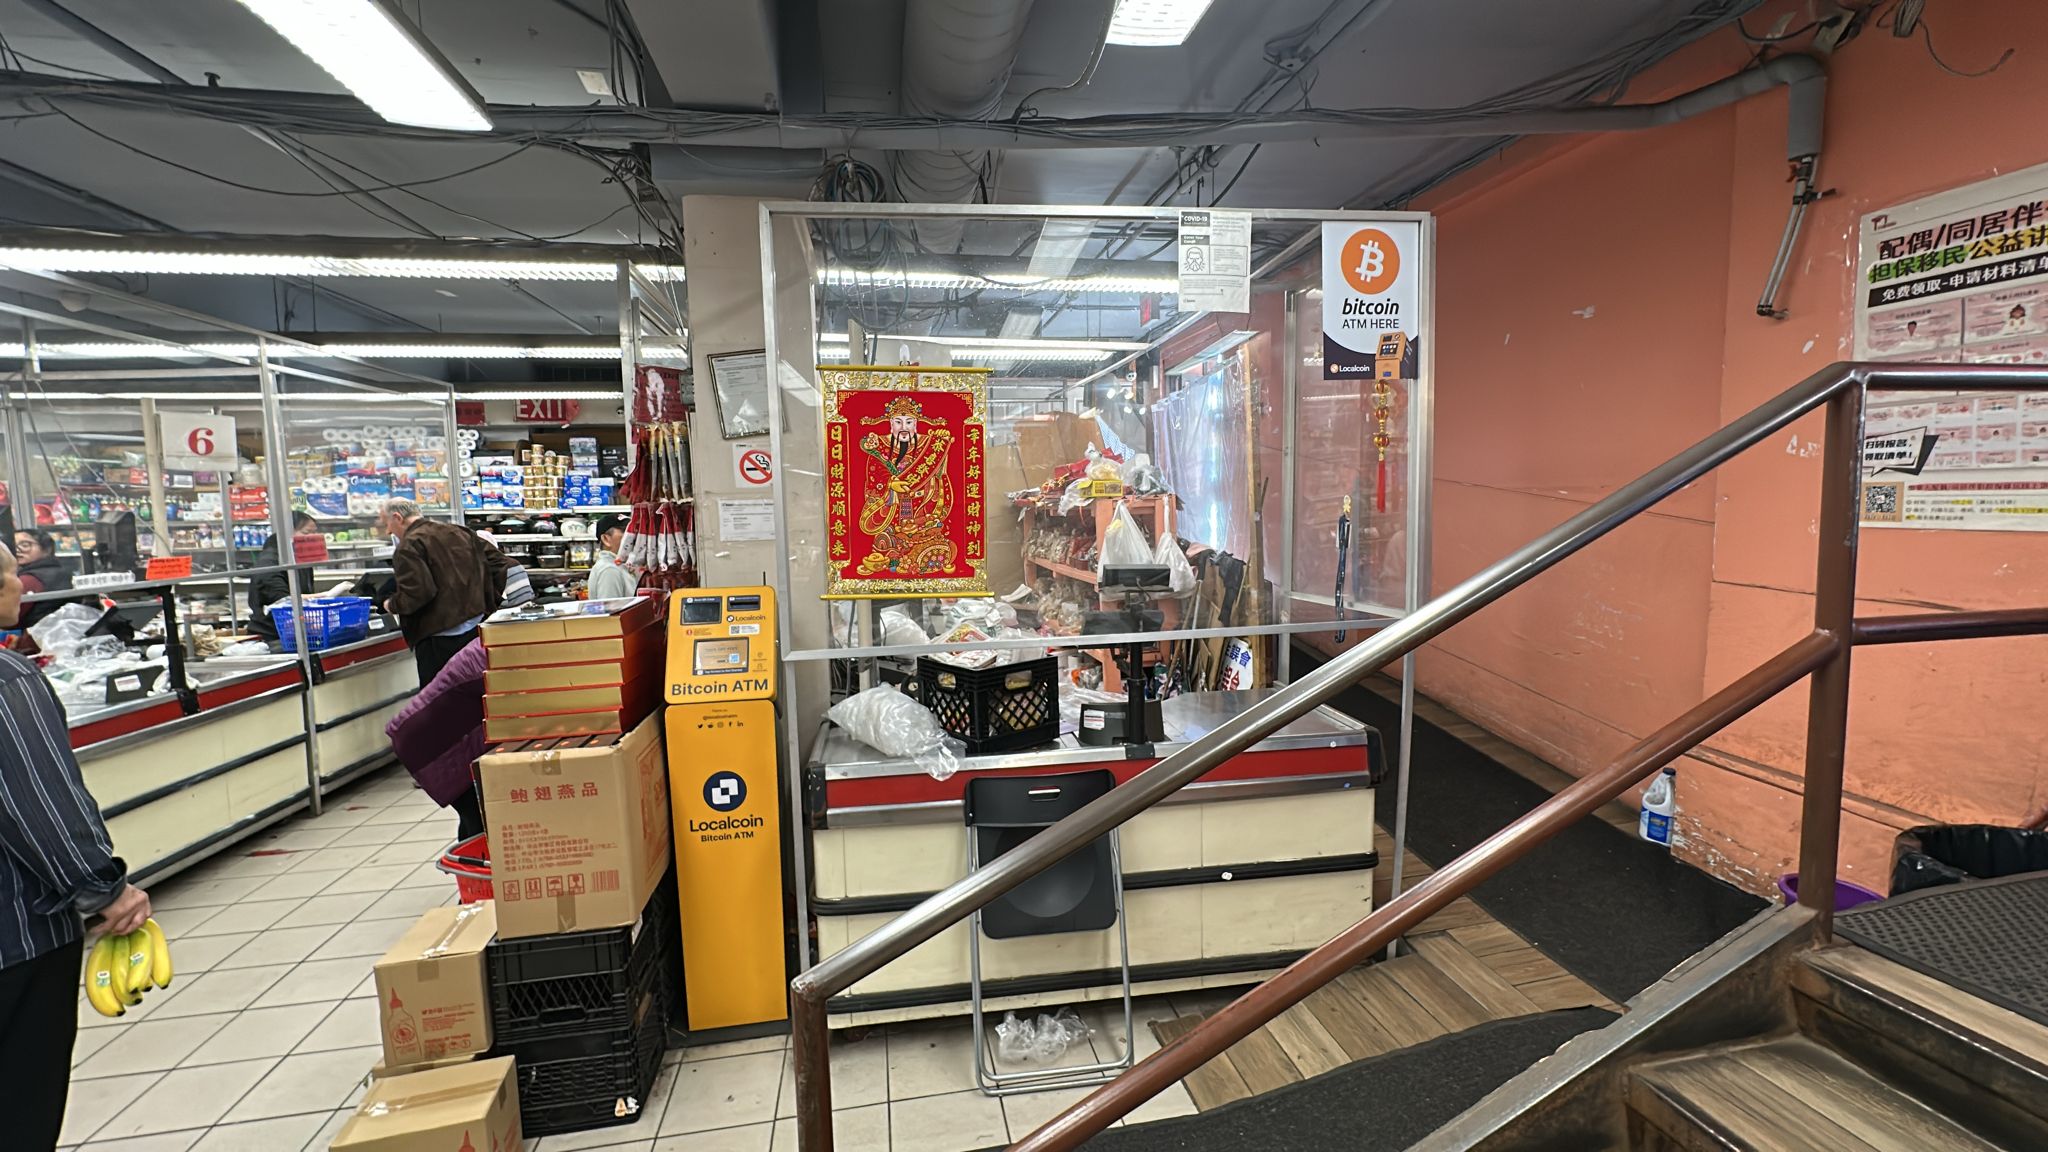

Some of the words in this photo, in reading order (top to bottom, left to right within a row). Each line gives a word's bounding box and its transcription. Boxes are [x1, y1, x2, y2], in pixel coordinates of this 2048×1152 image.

[1879, 200, 2048, 261] 配偶/同居伴
[1342, 297, 1399, 315] bitcoin
[1342, 318, 1367, 329] ATM
[1370, 318, 1399, 329] HERE
[1339, 364, 1370, 373] Localcoin
[188, 427, 215, 456] 6
[735, 614, 766, 622] Localcoin
[672, 681, 727, 696] Bitcoin
[732, 678, 768, 692] ATM
[690, 815, 763, 833] Localcoin
[701, 833, 732, 842] Bitcoin
[734, 831, 754, 840] ATM
